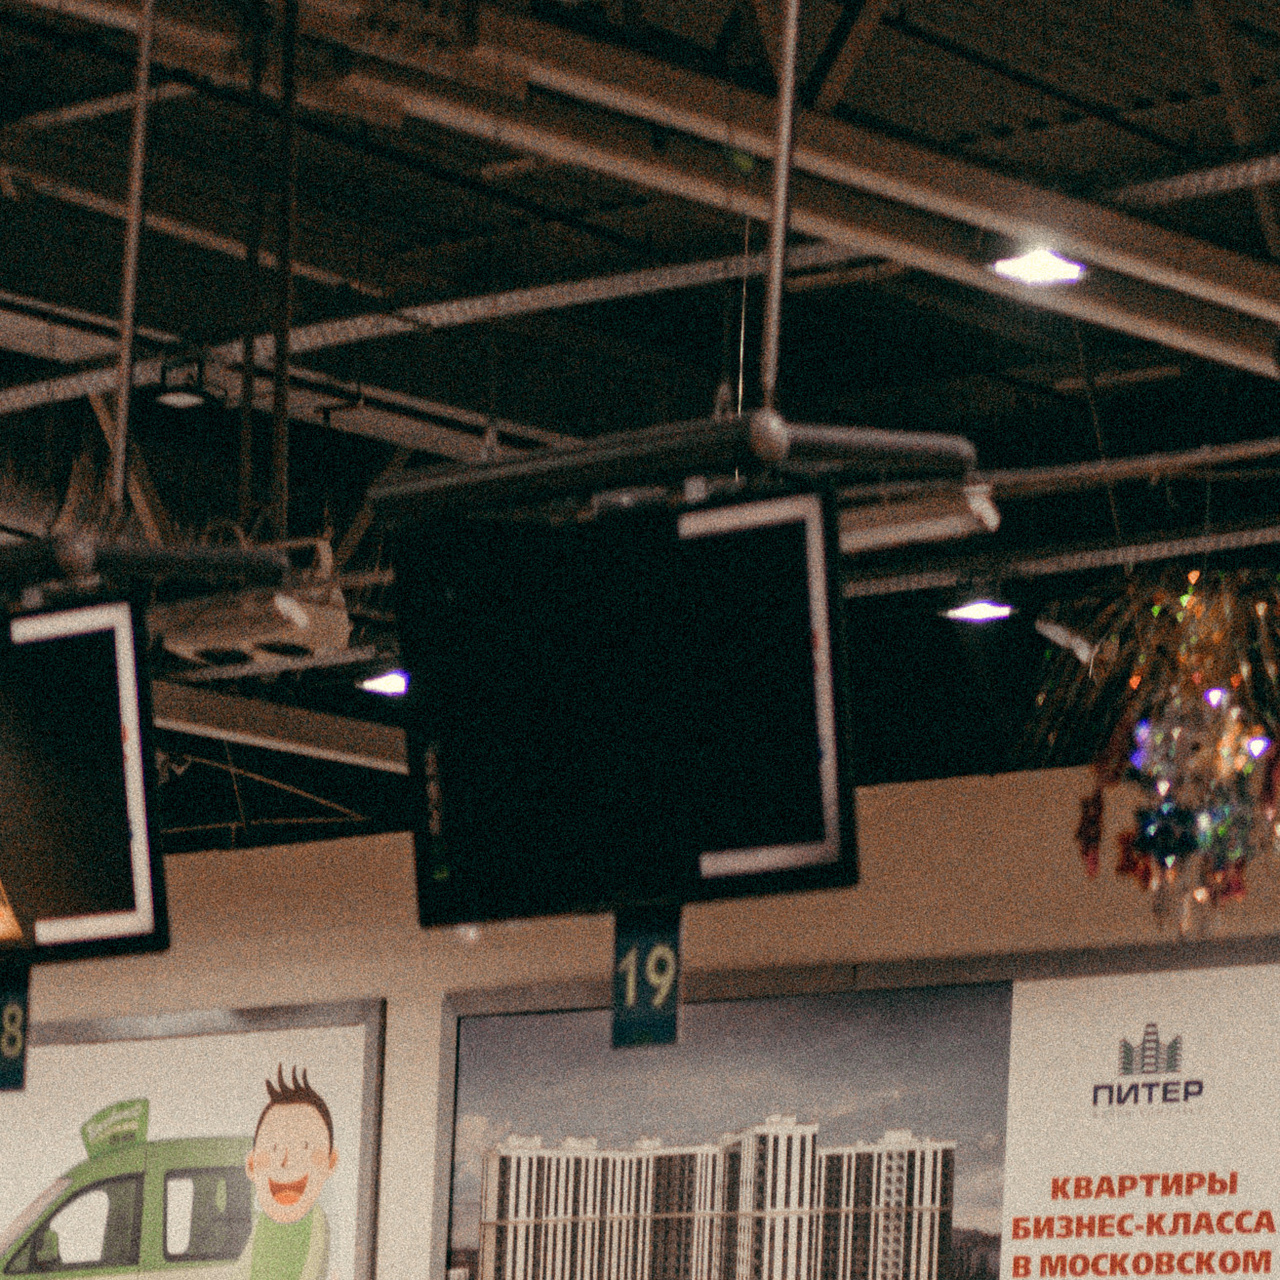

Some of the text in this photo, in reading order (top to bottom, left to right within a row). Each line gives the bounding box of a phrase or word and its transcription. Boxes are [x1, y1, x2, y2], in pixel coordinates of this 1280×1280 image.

[619, 943, 677, 1010] 19
[1091, 1078, 1205, 1108] ПИТЕР
[1049, 1170, 1239, 1201] КВАРТИРЫ
[1010, 1208, 1277, 1241] БИЗНЕС-КЛАССА
[1011, 1248, 1273, 1279] В МОСКОВСКОМ
